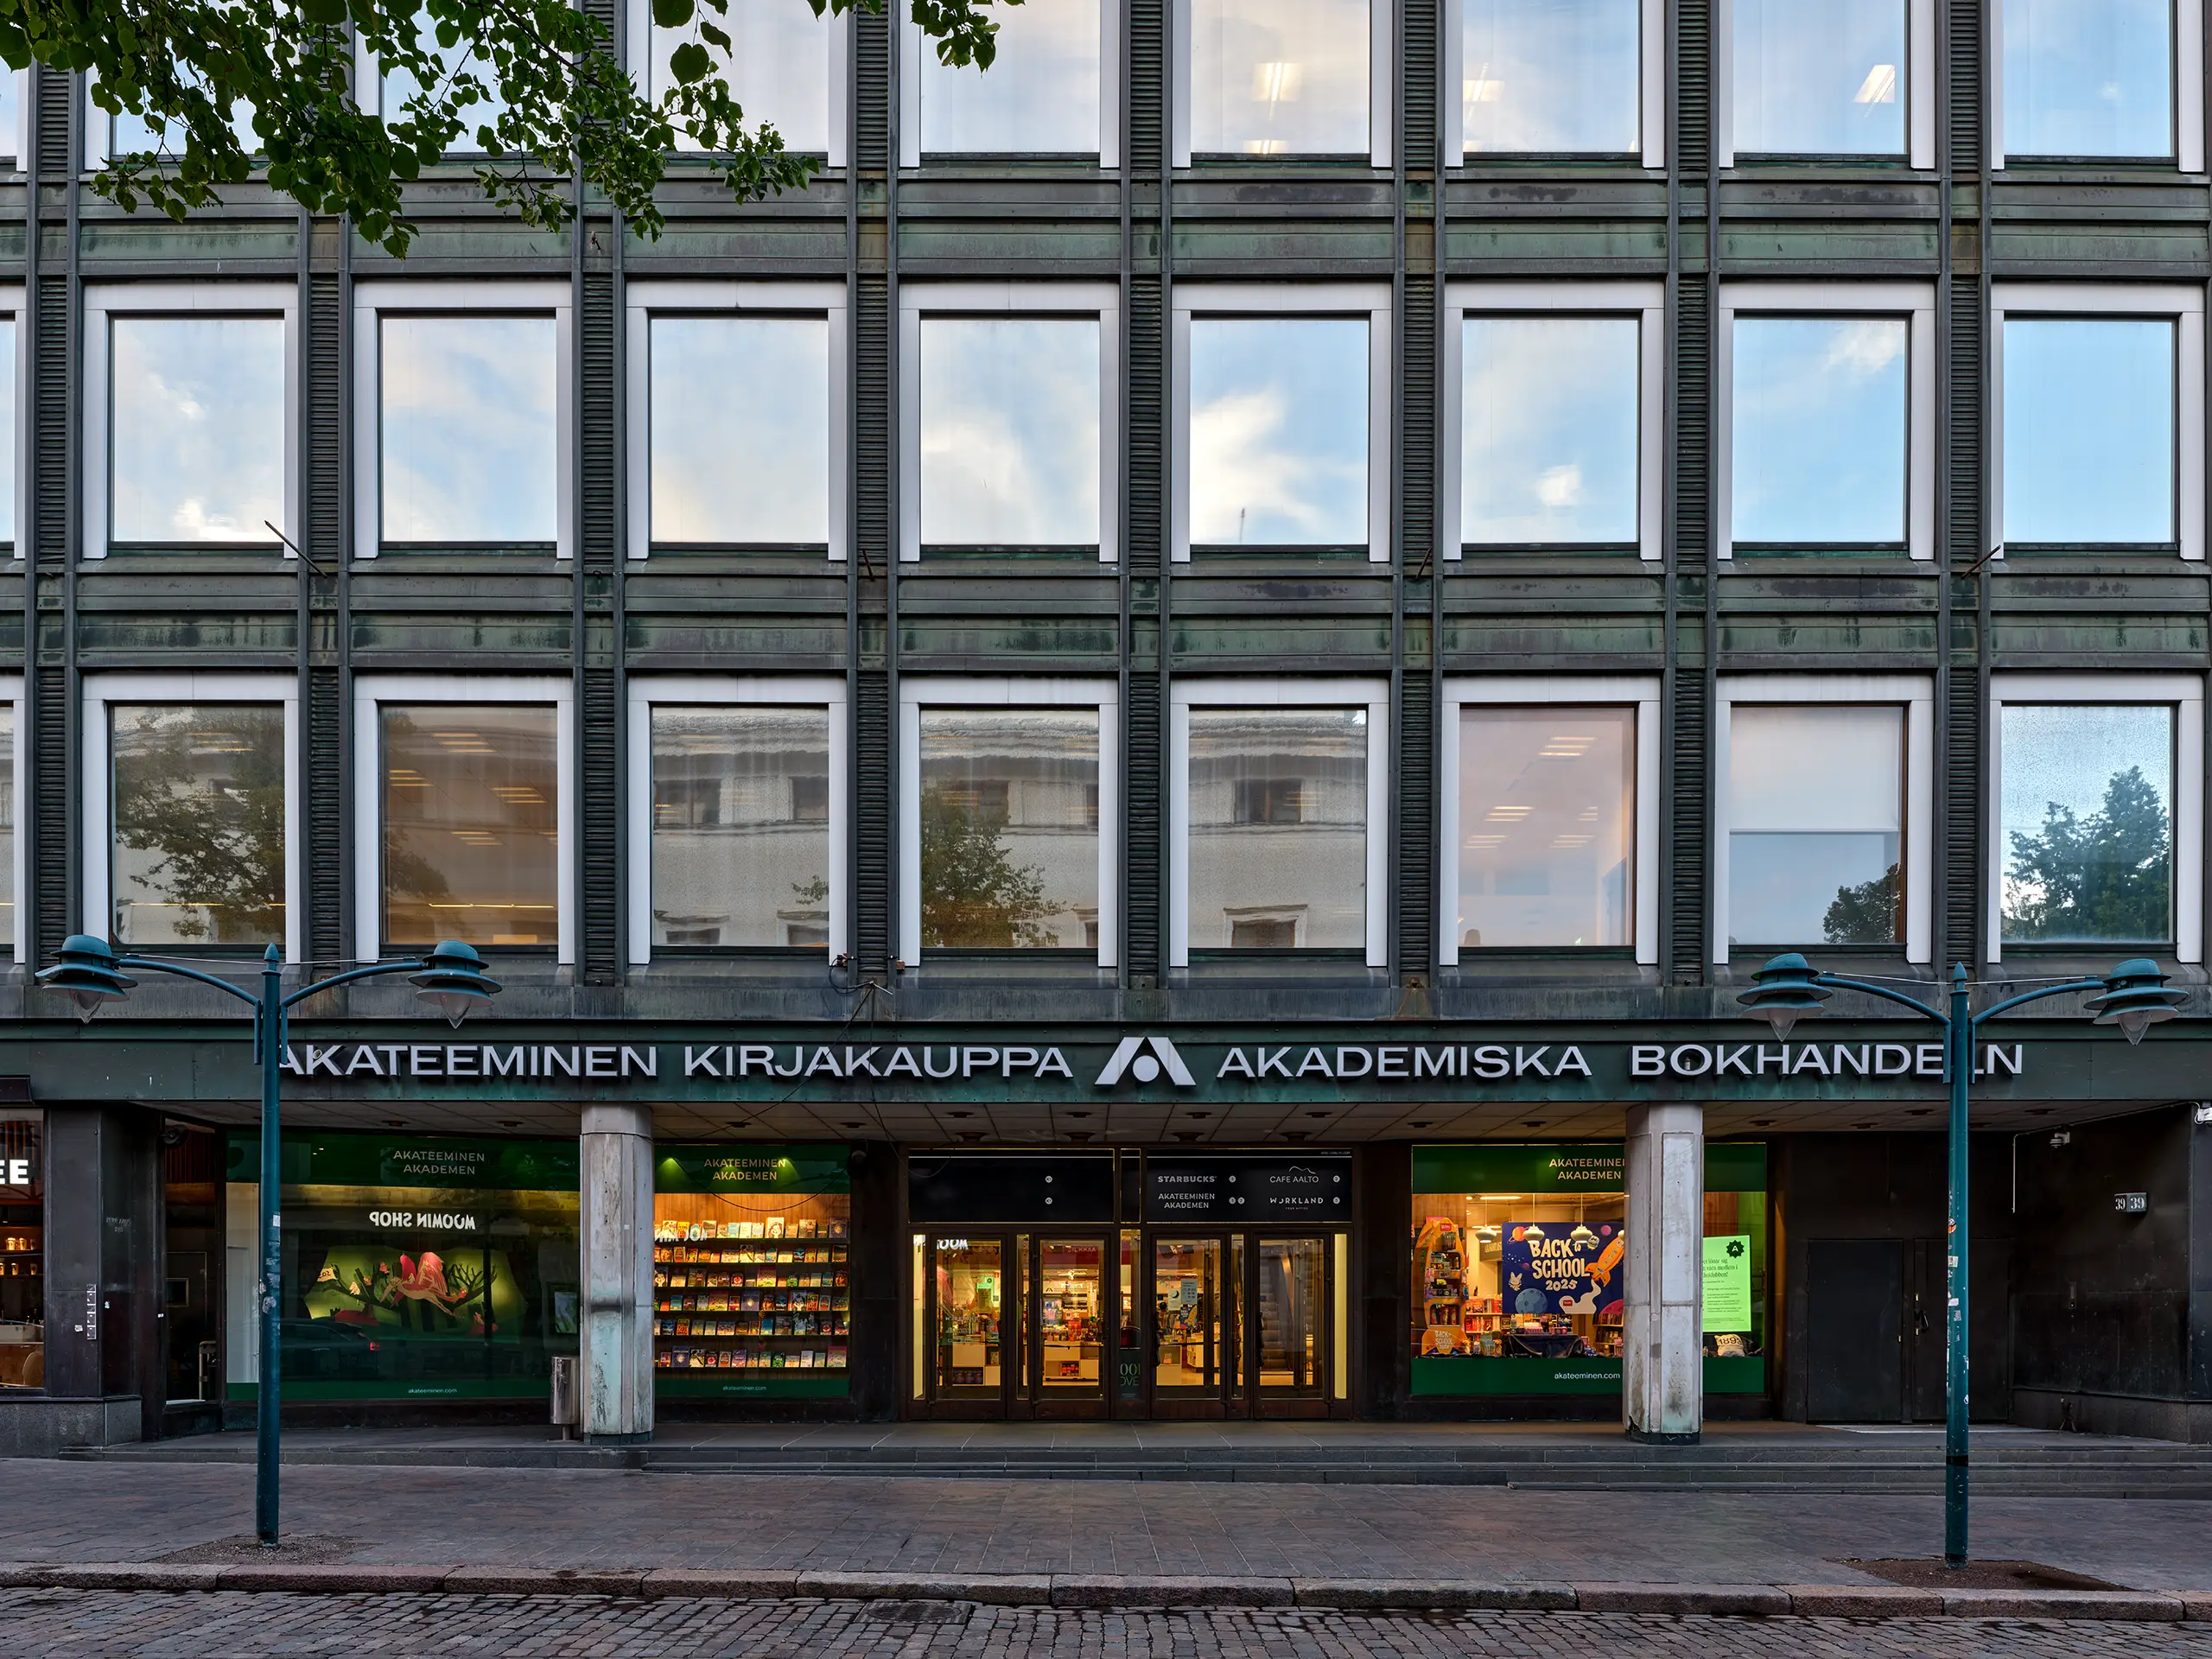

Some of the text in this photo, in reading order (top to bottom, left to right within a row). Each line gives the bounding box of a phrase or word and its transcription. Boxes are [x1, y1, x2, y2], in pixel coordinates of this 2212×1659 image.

[683, 1045, 1074, 1077] KIRJAKAUPPA
[1216, 1043, 2023, 1077] AKADEMISKA BOKHANDEN
[393, 1150, 486, 1162] AKATEEMINEN
[703, 1158, 786, 1168] AKATEEMINEN
[1548, 1158, 1624, 1167] AKATEEMINE
[403, 1164, 475, 1175] AKADEMEN
[712, 1171, 778, 1180] AKADEMEN
[1557, 1171, 1622, 1180] AKADEMEN
[2115, 1198, 2126, 1210] 39
[2130, 1197, 2145, 1210] 39
[1529, 1238, 1574, 1258] BACK
[1531, 1258, 1591, 1279] SCHOOL
[1545, 1279, 1578, 1291] 2025
[1554, 1371, 1621, 1380] akateeminen.com
